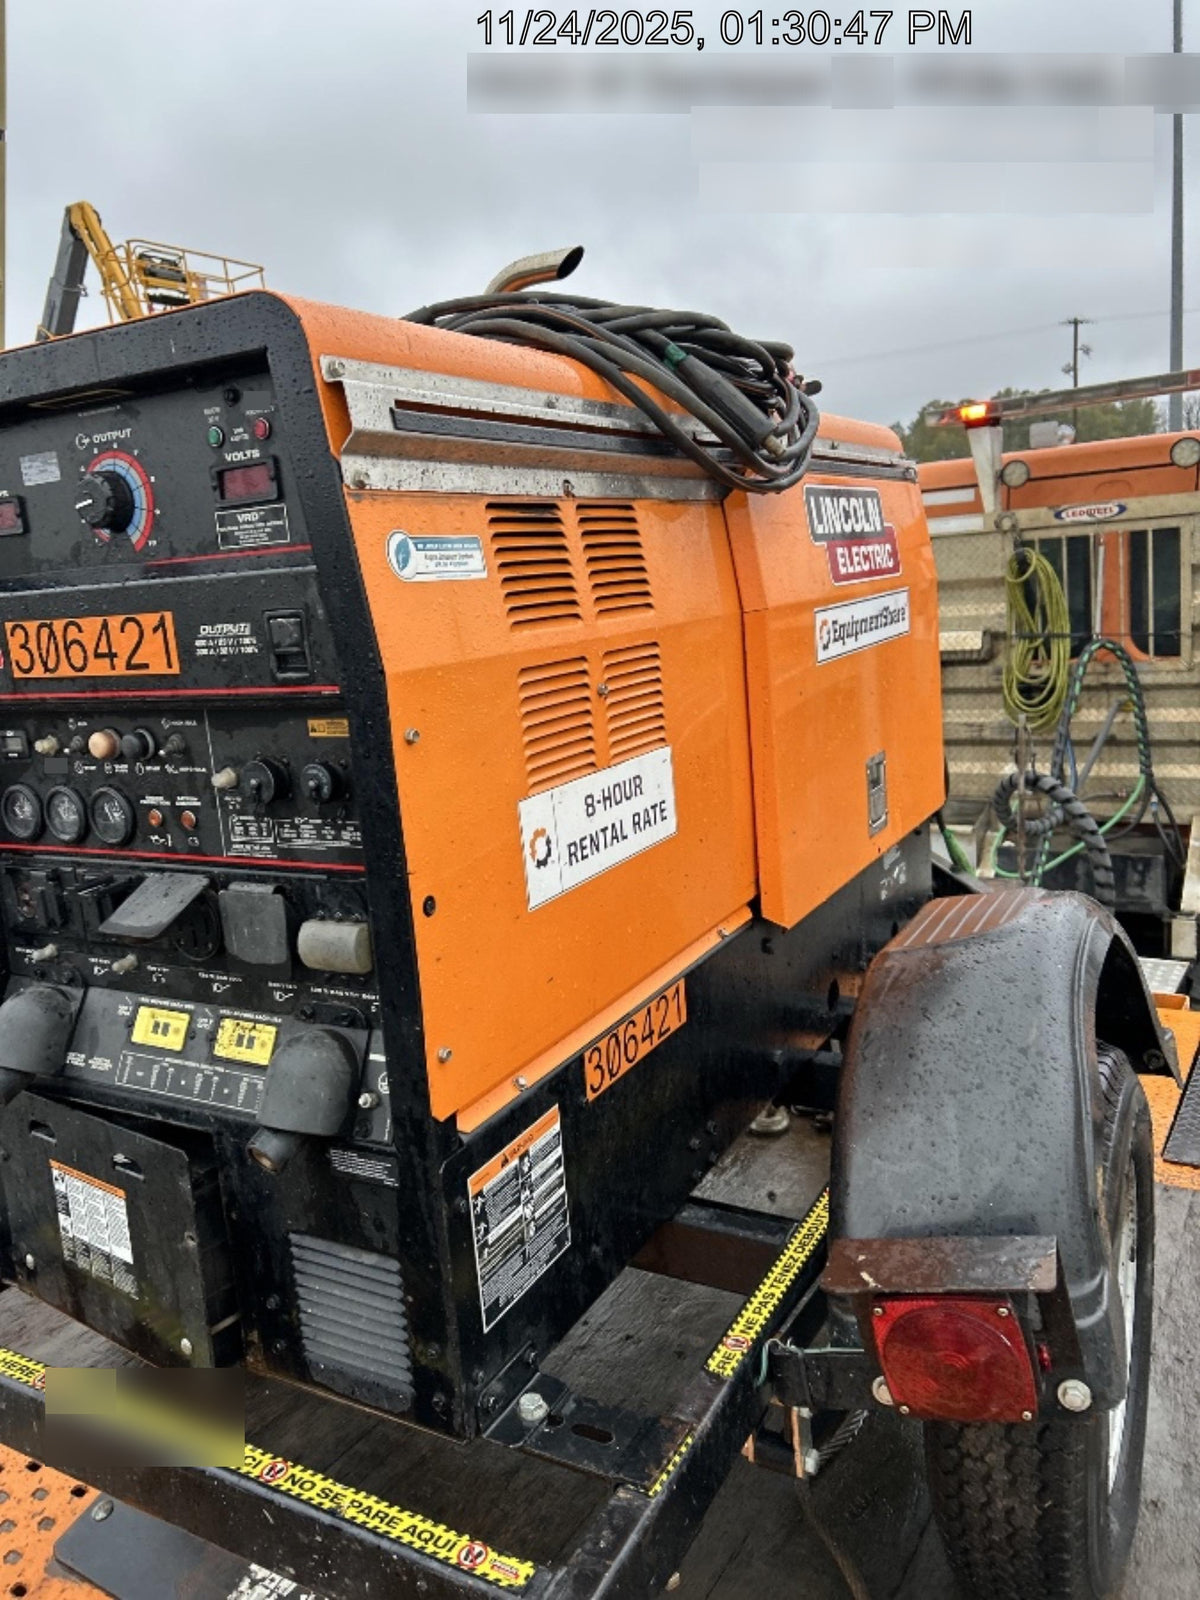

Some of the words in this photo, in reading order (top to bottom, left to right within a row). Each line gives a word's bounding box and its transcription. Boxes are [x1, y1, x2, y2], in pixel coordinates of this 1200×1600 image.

[93, 428, 132, 443] OUTPUT
[224, 449, 260, 461] VOLTS
[810, 496, 881, 534] LINCOLN
[836, 543, 894, 575] ELECTRIC
[10, 614, 173, 675] 306421
[831, 605, 906, 647] EquipmentShare
[584, 775, 643, 818] 8-HOUR
[567, 820, 628, 867] RENTAL
[632, 800, 668, 834] RATE
[588, 983, 682, 1094] 306421
[740, 1317, 759, 1335] NE
[753, 1292, 776, 1317] PAS
[769, 1256, 798, 1292] TENEZ
[285, 1472, 316, 1494] NO
[316, 1486, 343, 1506] SE
[344, 1500, 404, 1530] PARE
